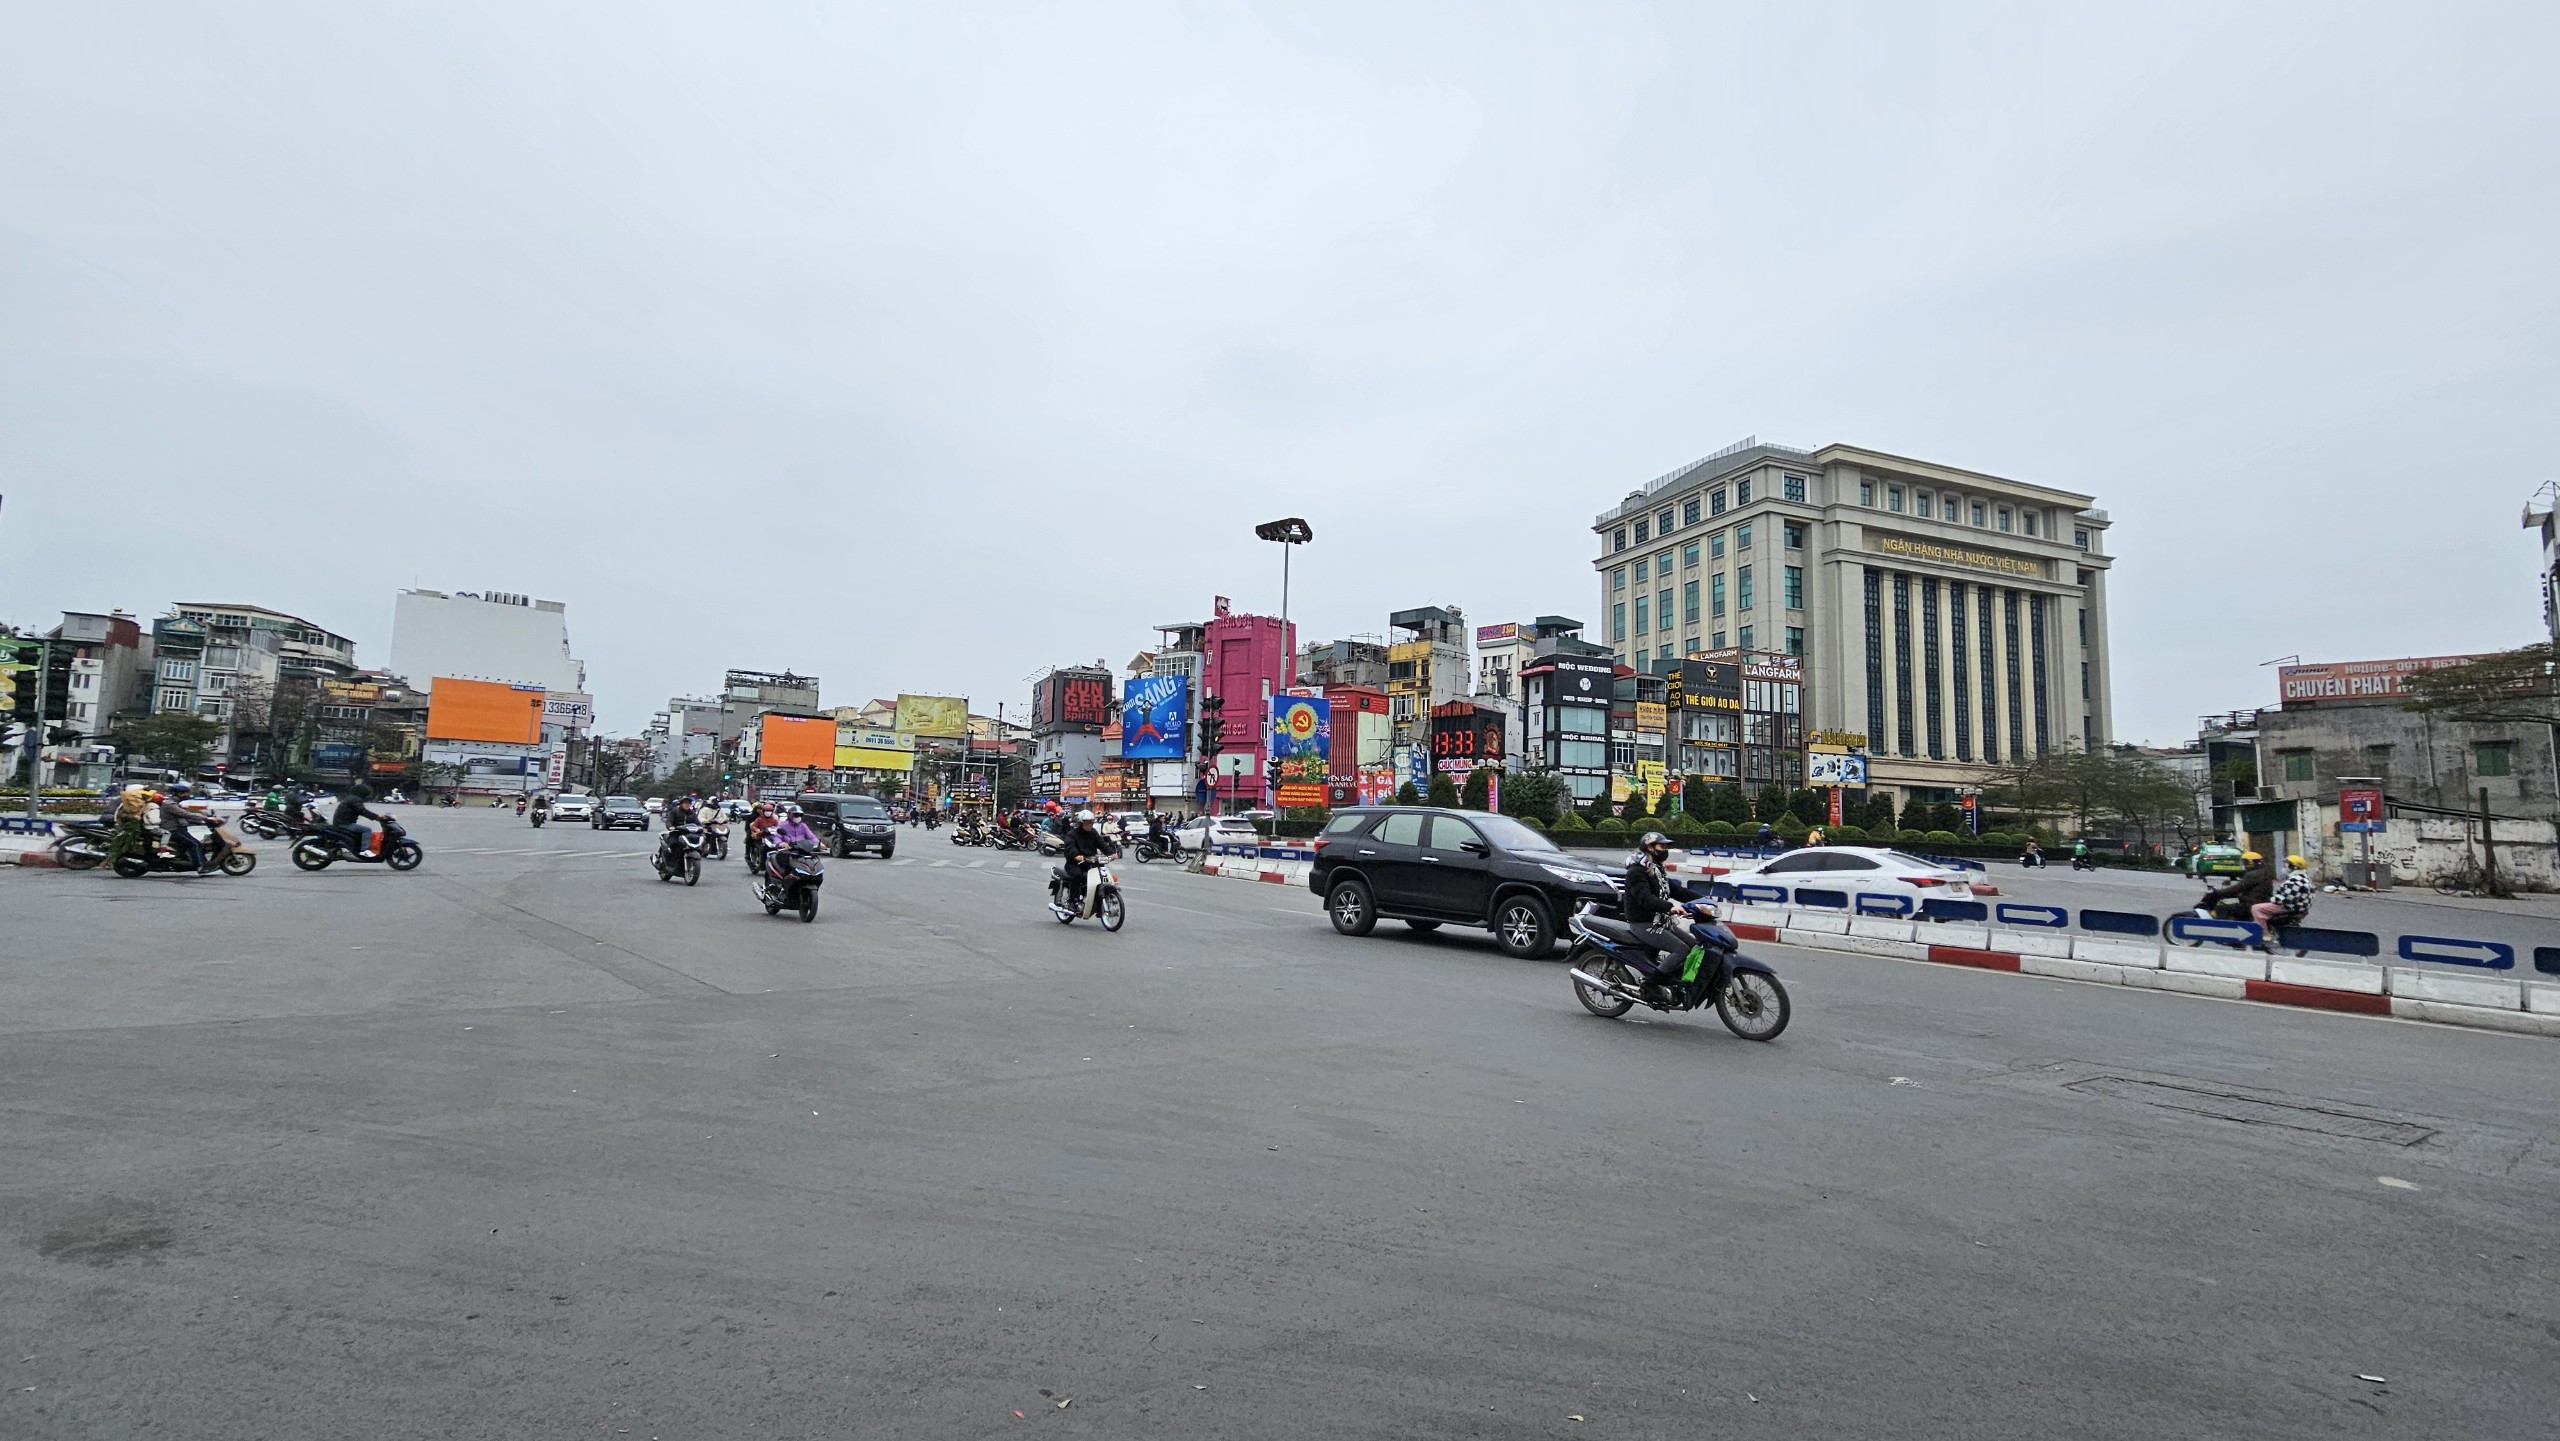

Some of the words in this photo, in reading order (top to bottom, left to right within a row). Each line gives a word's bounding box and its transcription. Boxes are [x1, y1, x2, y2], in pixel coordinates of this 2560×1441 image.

[1883, 538, 1911, 552] NGÂN
[1914, 542, 1941, 558] HÀNG
[1944, 548, 1964, 562] NHÀ
[1966, 552, 1993, 566] NƯỚC
[1996, 556, 2015, 571] VIỆT
[2018, 562, 2037, 574] NAM
[1700, 650, 1738, 660] L'ANGFARM
[1577, 664, 1612, 674] WEDDING
[1744, 665, 1800, 680] L'ANGFARM
[2345, 663, 2392, 675] Hotline:
[1064, 680, 1103, 694] JUN
[2286, 671, 2346, 698] CHUYỂN
[2352, 670, 2392, 694] PHÁT
[1064, 694, 1104, 708] GER
[1135, 676, 1176, 714] SÁNG
[1685, 692, 1699, 706] THẾ
[1701, 695, 1716, 708] GIỚI
[1718, 696, 1728, 708] ÁO
[1730, 700, 1740, 710] DA
[1670, 700, 1680, 708] DA
[1164, 720, 1182, 728] APOLLO
[1435, 730, 1474, 755] 13:33
